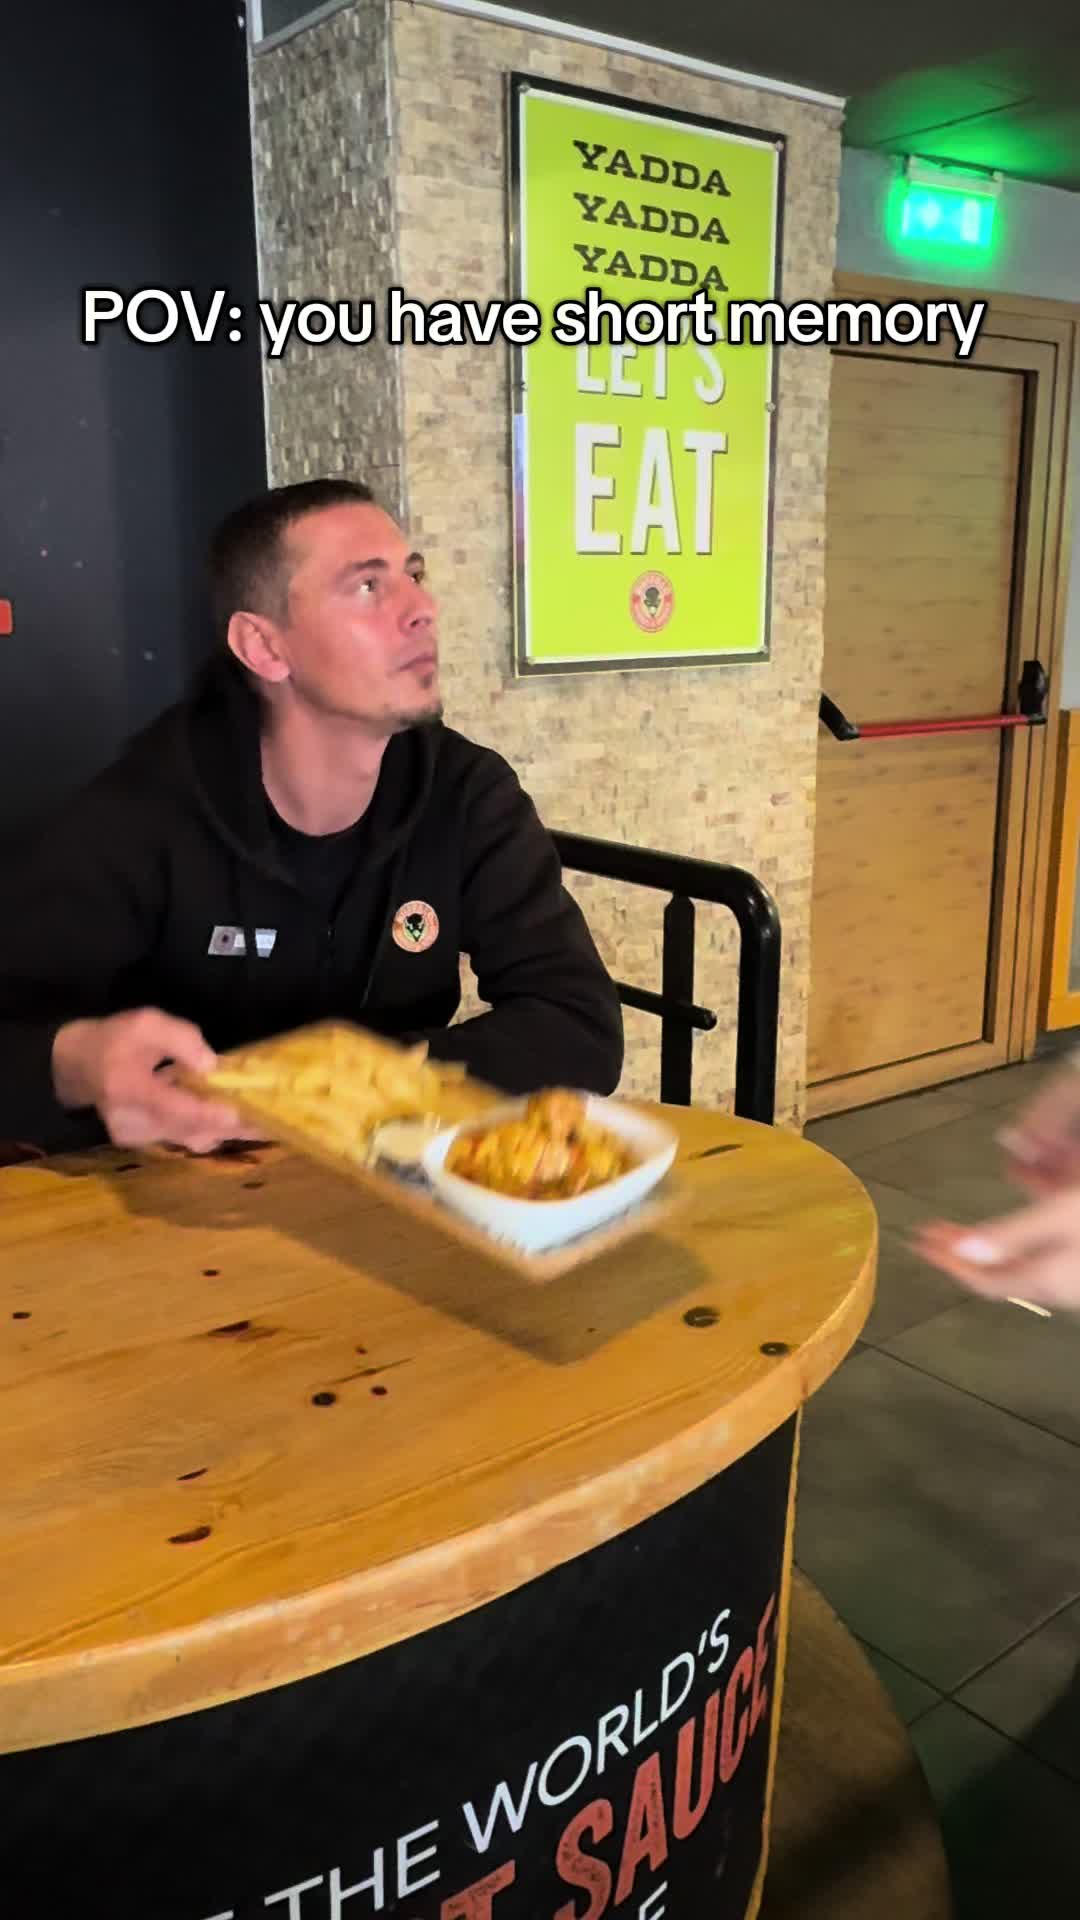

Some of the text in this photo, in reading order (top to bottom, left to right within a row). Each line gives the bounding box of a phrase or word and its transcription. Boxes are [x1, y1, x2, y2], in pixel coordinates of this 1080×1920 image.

[572, 139, 732, 198] YADDA
[572, 191, 731, 246] YADDA
[572, 243, 729, 292] YADDA
[573, 423, 728, 556] EAT
[263, 1608, 731, 1920] THE WORLD'S
